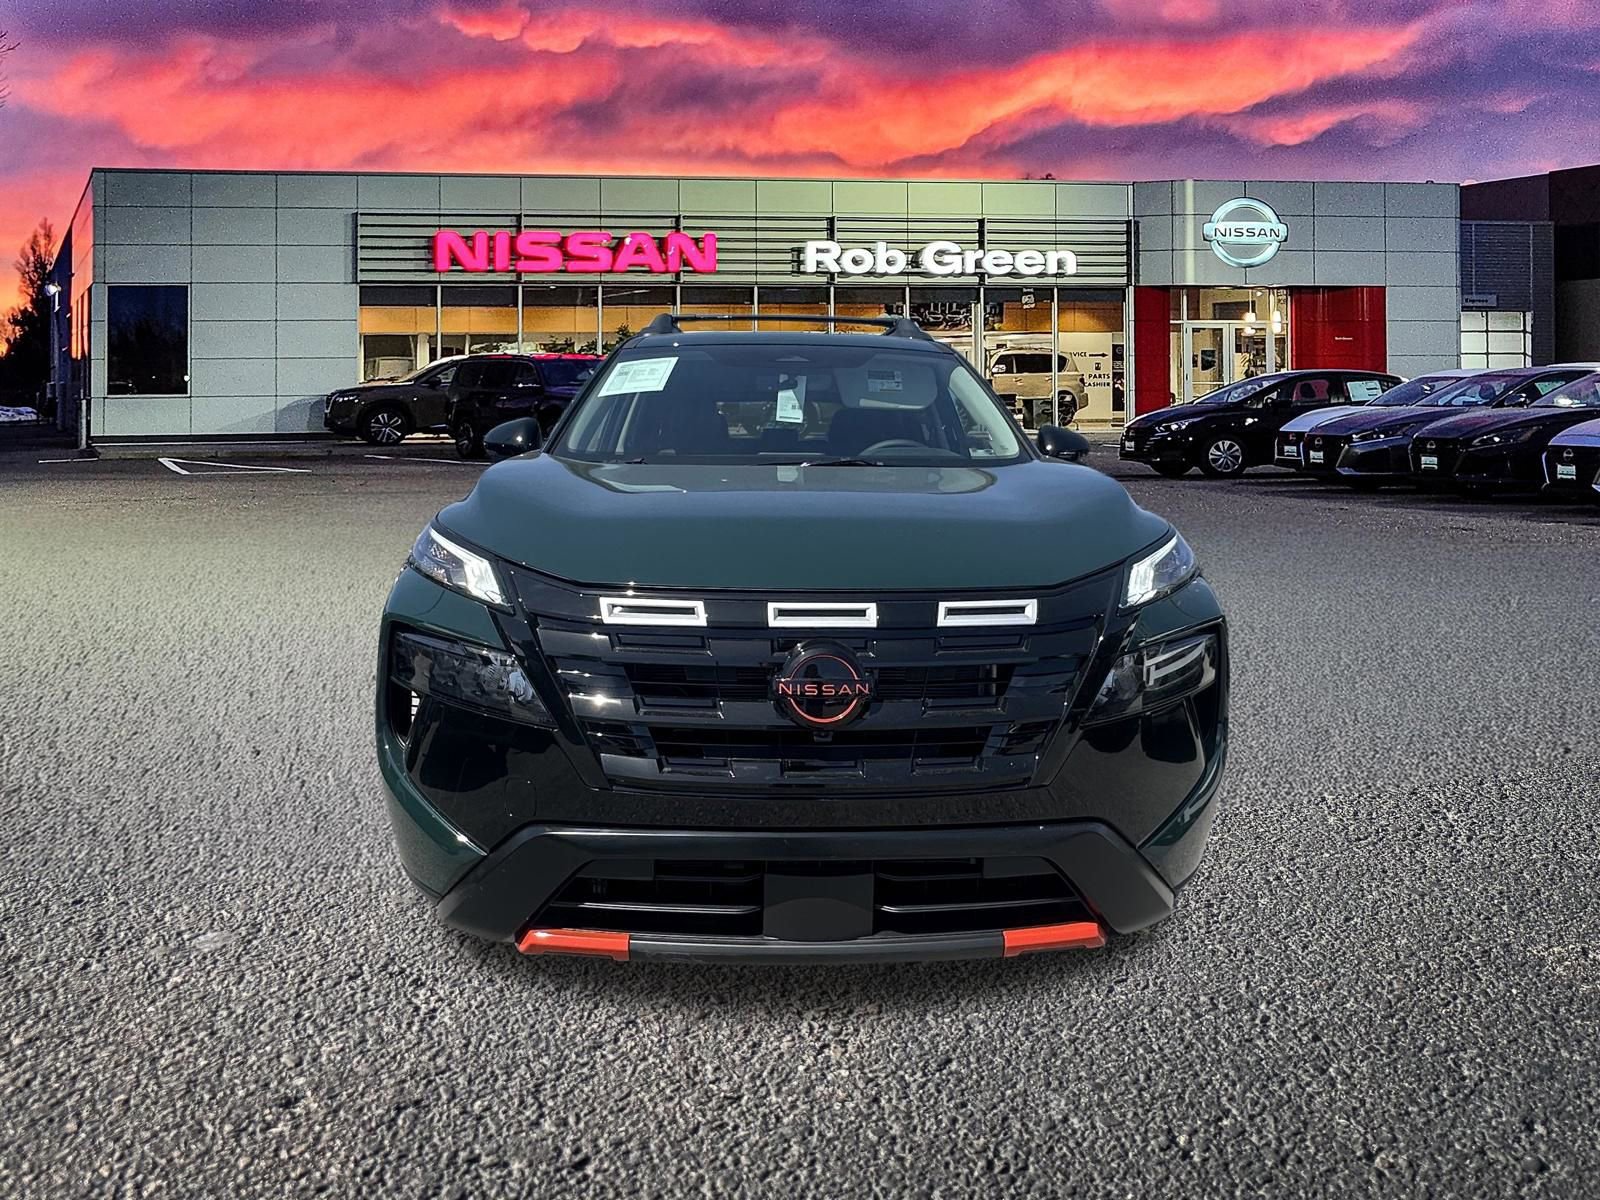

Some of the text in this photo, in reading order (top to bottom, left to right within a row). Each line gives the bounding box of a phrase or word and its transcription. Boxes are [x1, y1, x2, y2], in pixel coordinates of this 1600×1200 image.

[1214, 226, 1281, 239] NISSAN
[433, 229, 719, 274] NISSAN
[803, 240, 1077, 276] Rob Green
[778, 683, 870, 696] NISSAN
